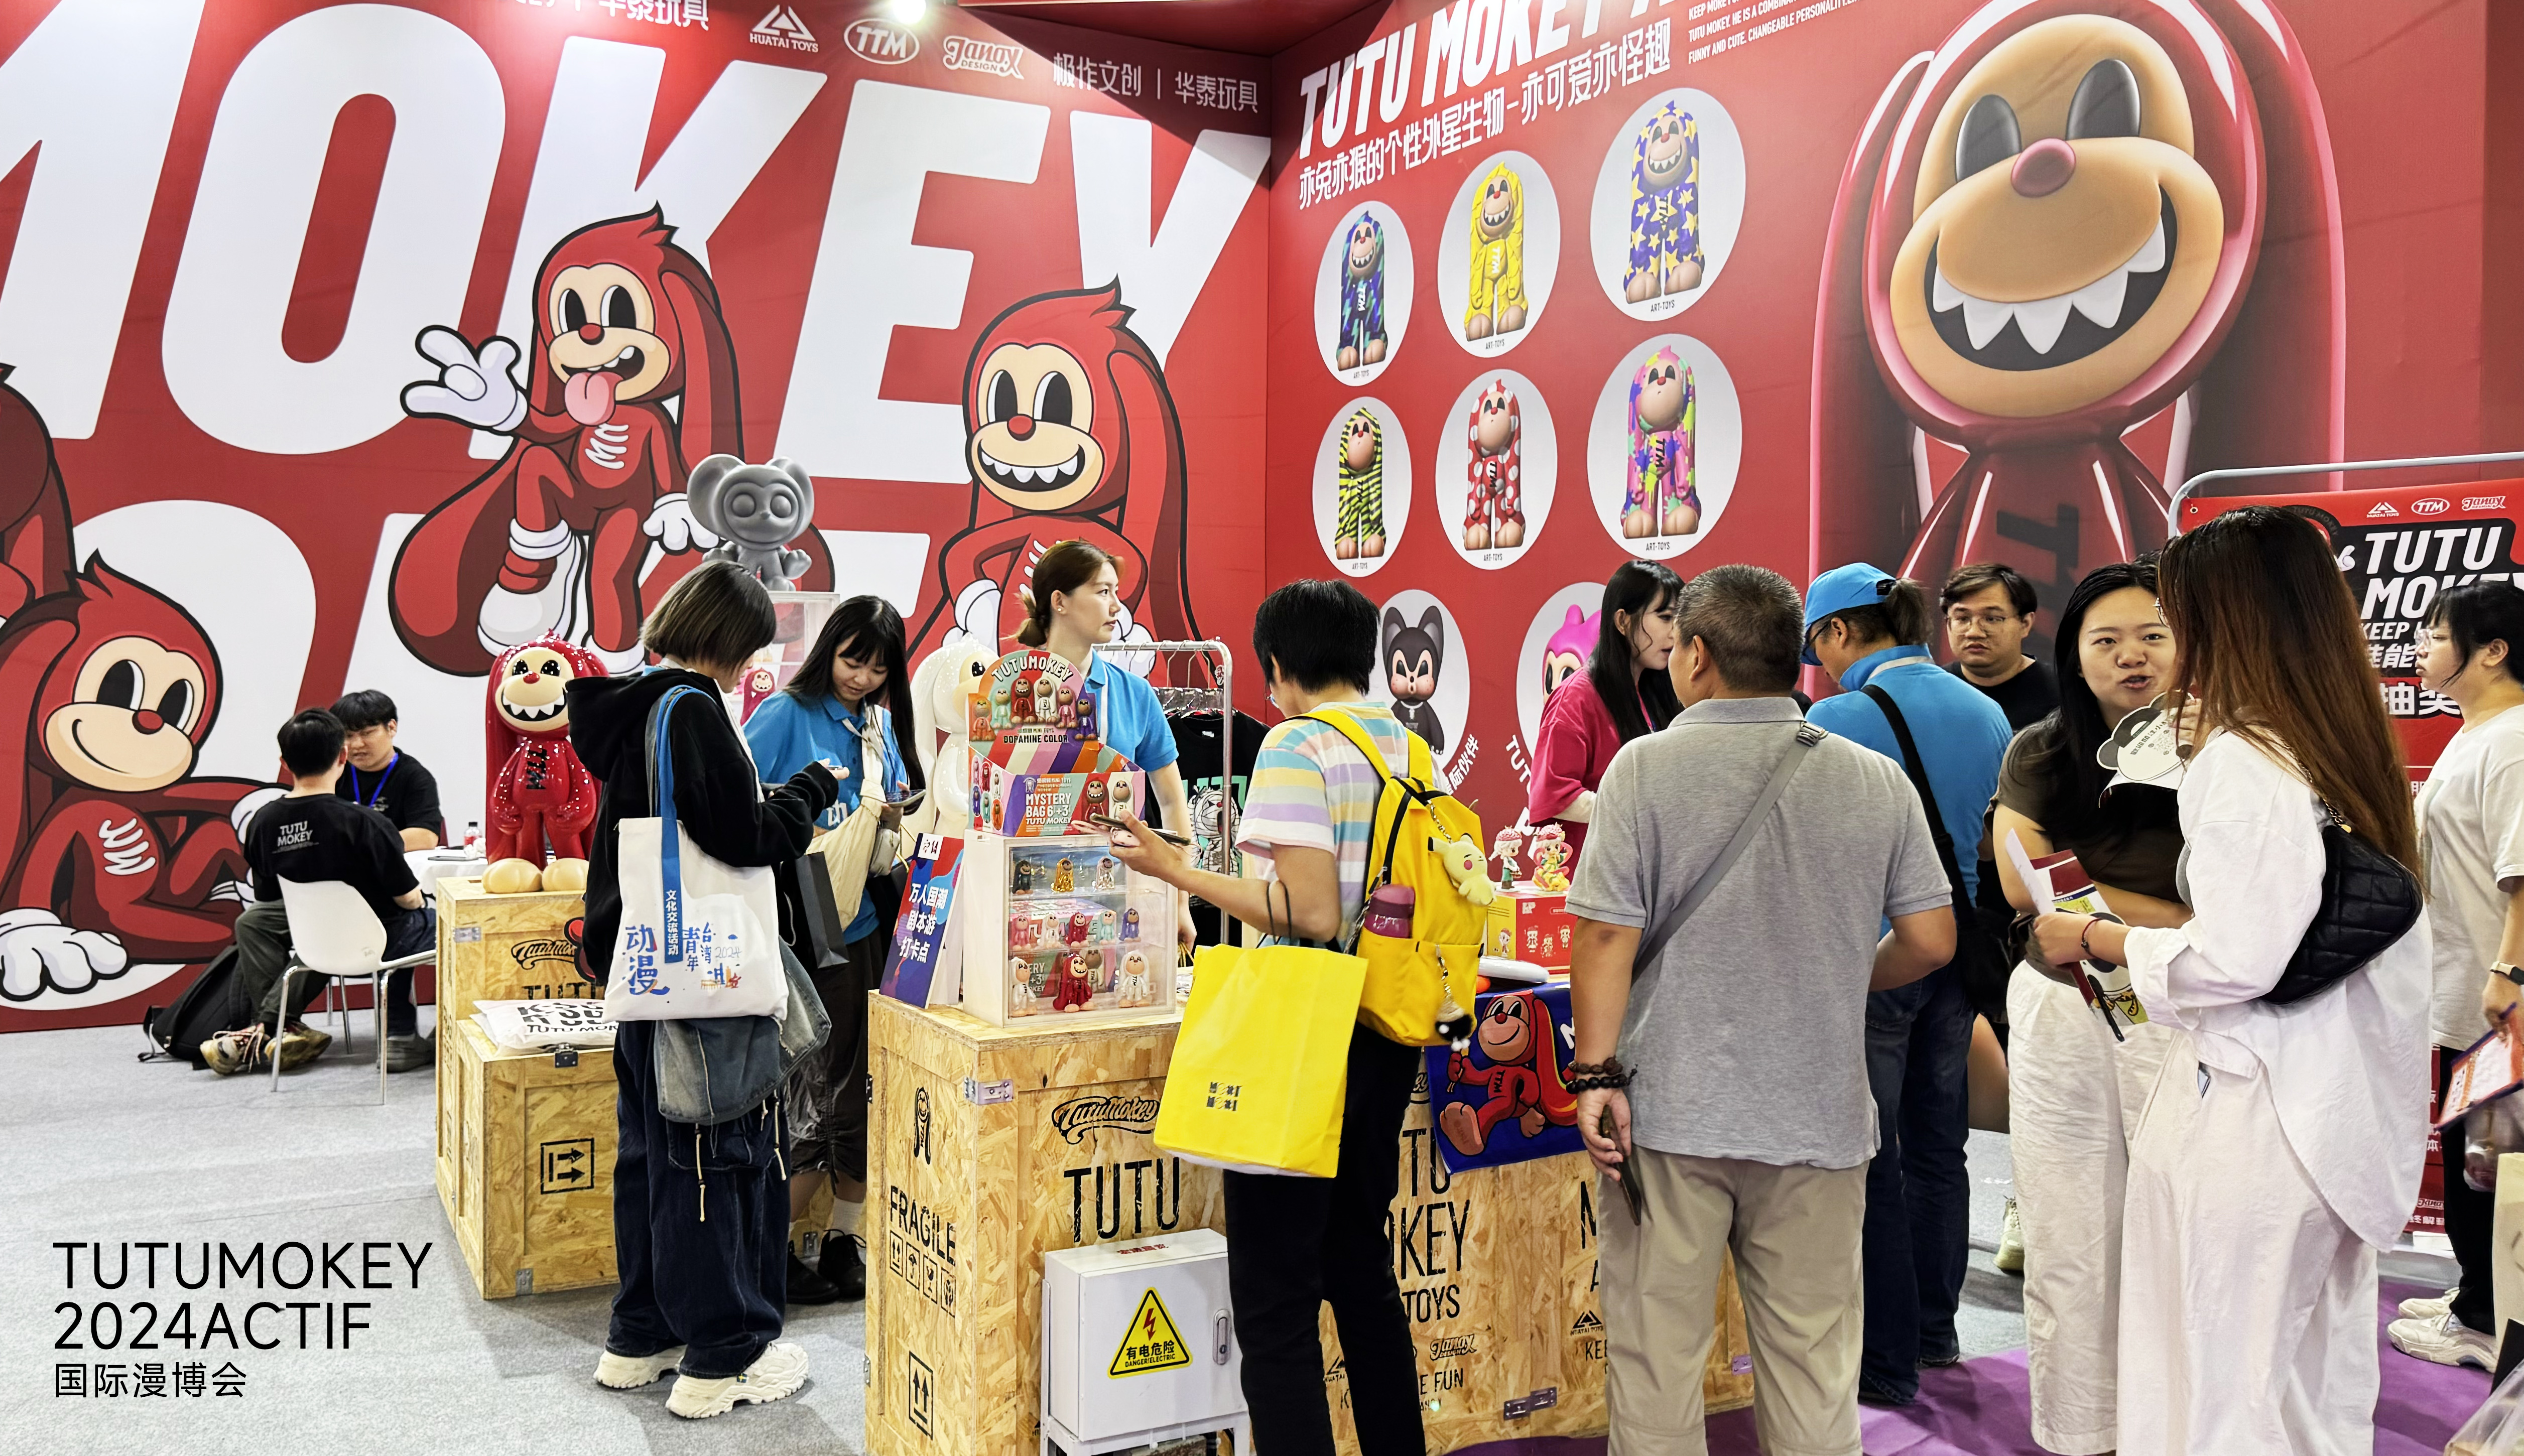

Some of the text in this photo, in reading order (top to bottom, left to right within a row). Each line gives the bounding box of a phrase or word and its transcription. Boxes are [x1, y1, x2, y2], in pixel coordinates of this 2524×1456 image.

[1689, 3, 1706, 21] KEEP
[1689, 27, 1705, 42] TUTU
[1732, 10, 1742, 26] HE
[1743, 7, 1750, 21] IS
[1751, 5, 1756, 18] A
[750, 33, 818, 52] HUATAI TOYS
[856, 27, 907, 58] TTM
[1688, 44, 1711, 64] FUNNY
[1712, 39, 1726, 56] AND
[1748, 13, 1795, 42] CHANGEABLE
[961, 59, 997, 72] DESIGN
[1054, 53, 1142, 97] 极作文创
[1175, 71, 1258, 113] 华泰玩具
[1299, 22, 1417, 160] TUTU
[1651, 300, 1675, 312] ART-TOYS
[1486, 339, 1505, 349] ART-TOYS
[1655, 438, 1665, 468] TTM
[1488, 461, 1497, 488] TTM
[2417, 501, 2444, 512] TTM
[1483, 553, 1503, 562] ART-TOYS
[1646, 541, 1671, 551] ART-TOYS
[2365, 526, 2502, 575] TUTU
[991, 656, 1073, 682] TUTUMOKEY
[1004, 734, 1069, 743] DOPAMINE COLOR
[1505, 734, 1532, 795] TUT
[1026, 793, 1071, 806] MYSTERY
[1026, 806, 1046, 818] BAG
[280, 820, 308, 835] TUTU
[1047, 817, 1072, 825] MOKEY
[277, 830, 313, 847] MOKEY
[909, 883, 949, 909] 万人国潮
[666, 890, 679, 955] 文化交流活动
[625, 923, 671, 996] 动漫
[682, 926, 701, 972] 青年
[900, 936, 930, 963] 打卡点
[527, 1024, 573, 1033] TUTU
[1493, 1070, 1506, 1093] TTM
[1063, 1157, 1180, 1243] TUTU
[890, 1185, 956, 1267] FRAGILE
[1387, 1199, 1470, 1280] KEY
[1402, 1284, 1460, 1323] TOYS
[1126, 1340, 1175, 1360] 有电危险
[1434, 1367, 1463, 1392] FUN
